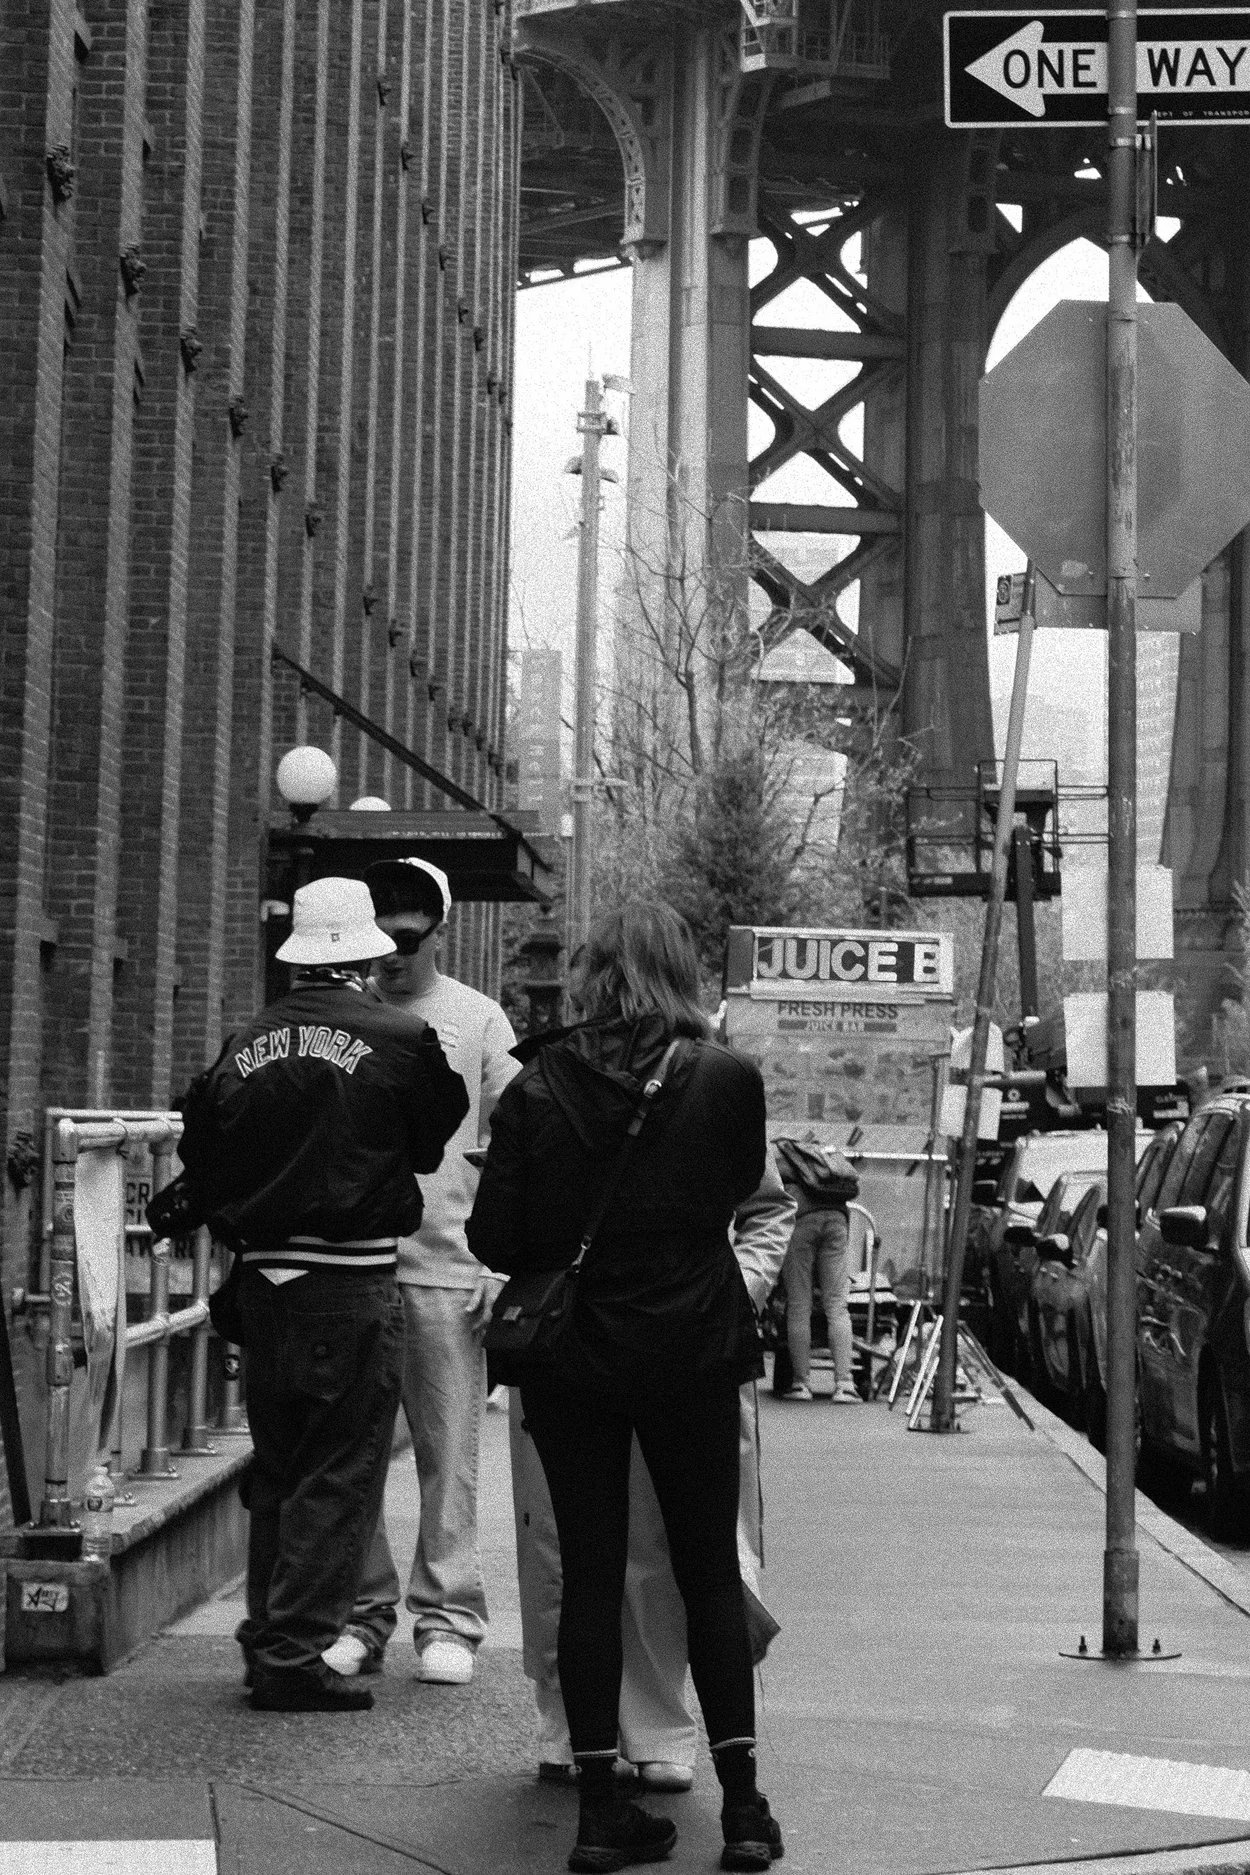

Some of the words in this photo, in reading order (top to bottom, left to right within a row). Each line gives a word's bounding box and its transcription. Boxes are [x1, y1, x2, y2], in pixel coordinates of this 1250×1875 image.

[1002, 48, 1098, 89] ONE
[1147, 46, 1248, 87] WAY
[757, 937, 900, 983] JUICE
[777, 1000, 836, 1018] FRESH
[840, 1002, 899, 1020] PRESS
[233, 1027, 291, 1079] NEW
[297, 1025, 374, 1075] YORK
